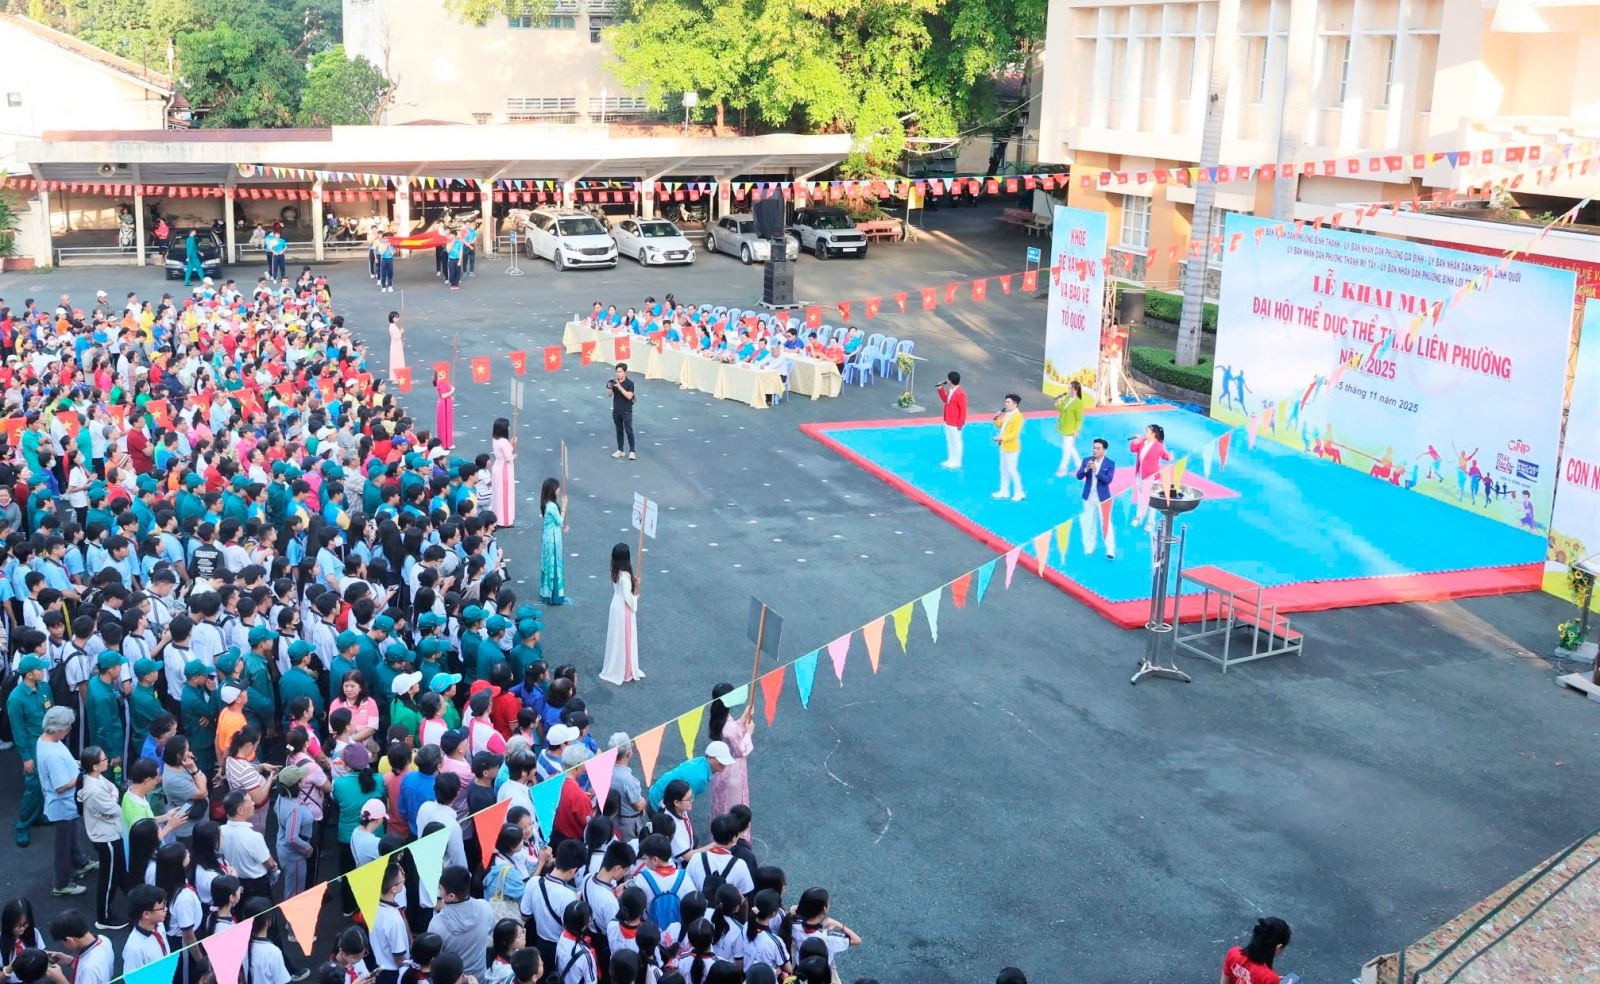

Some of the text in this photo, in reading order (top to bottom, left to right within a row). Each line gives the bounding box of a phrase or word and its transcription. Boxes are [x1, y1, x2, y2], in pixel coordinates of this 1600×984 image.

[1313, 268, 1336, 296] LỄ
[1341, 281, 1393, 308] KHAI
[1253, 296, 1271, 320] ĐẠI
[1275, 299, 1294, 325] HỘI
[1297, 301, 1322, 329] THỂ
[1323, 313, 1348, 338] DỤC
[1352, 314, 1379, 342] THỂ
[1417, 333, 1448, 362] LIÊN
[1452, 345, 1512, 379] PHƯỜNG
[1366, 358, 1396, 379] 2025
[1345, 383, 1367, 400] tháng
[1370, 391, 1377, 400] 11
[1399, 399, 1419, 413] 2025
[1566, 458, 1590, 487] CON
